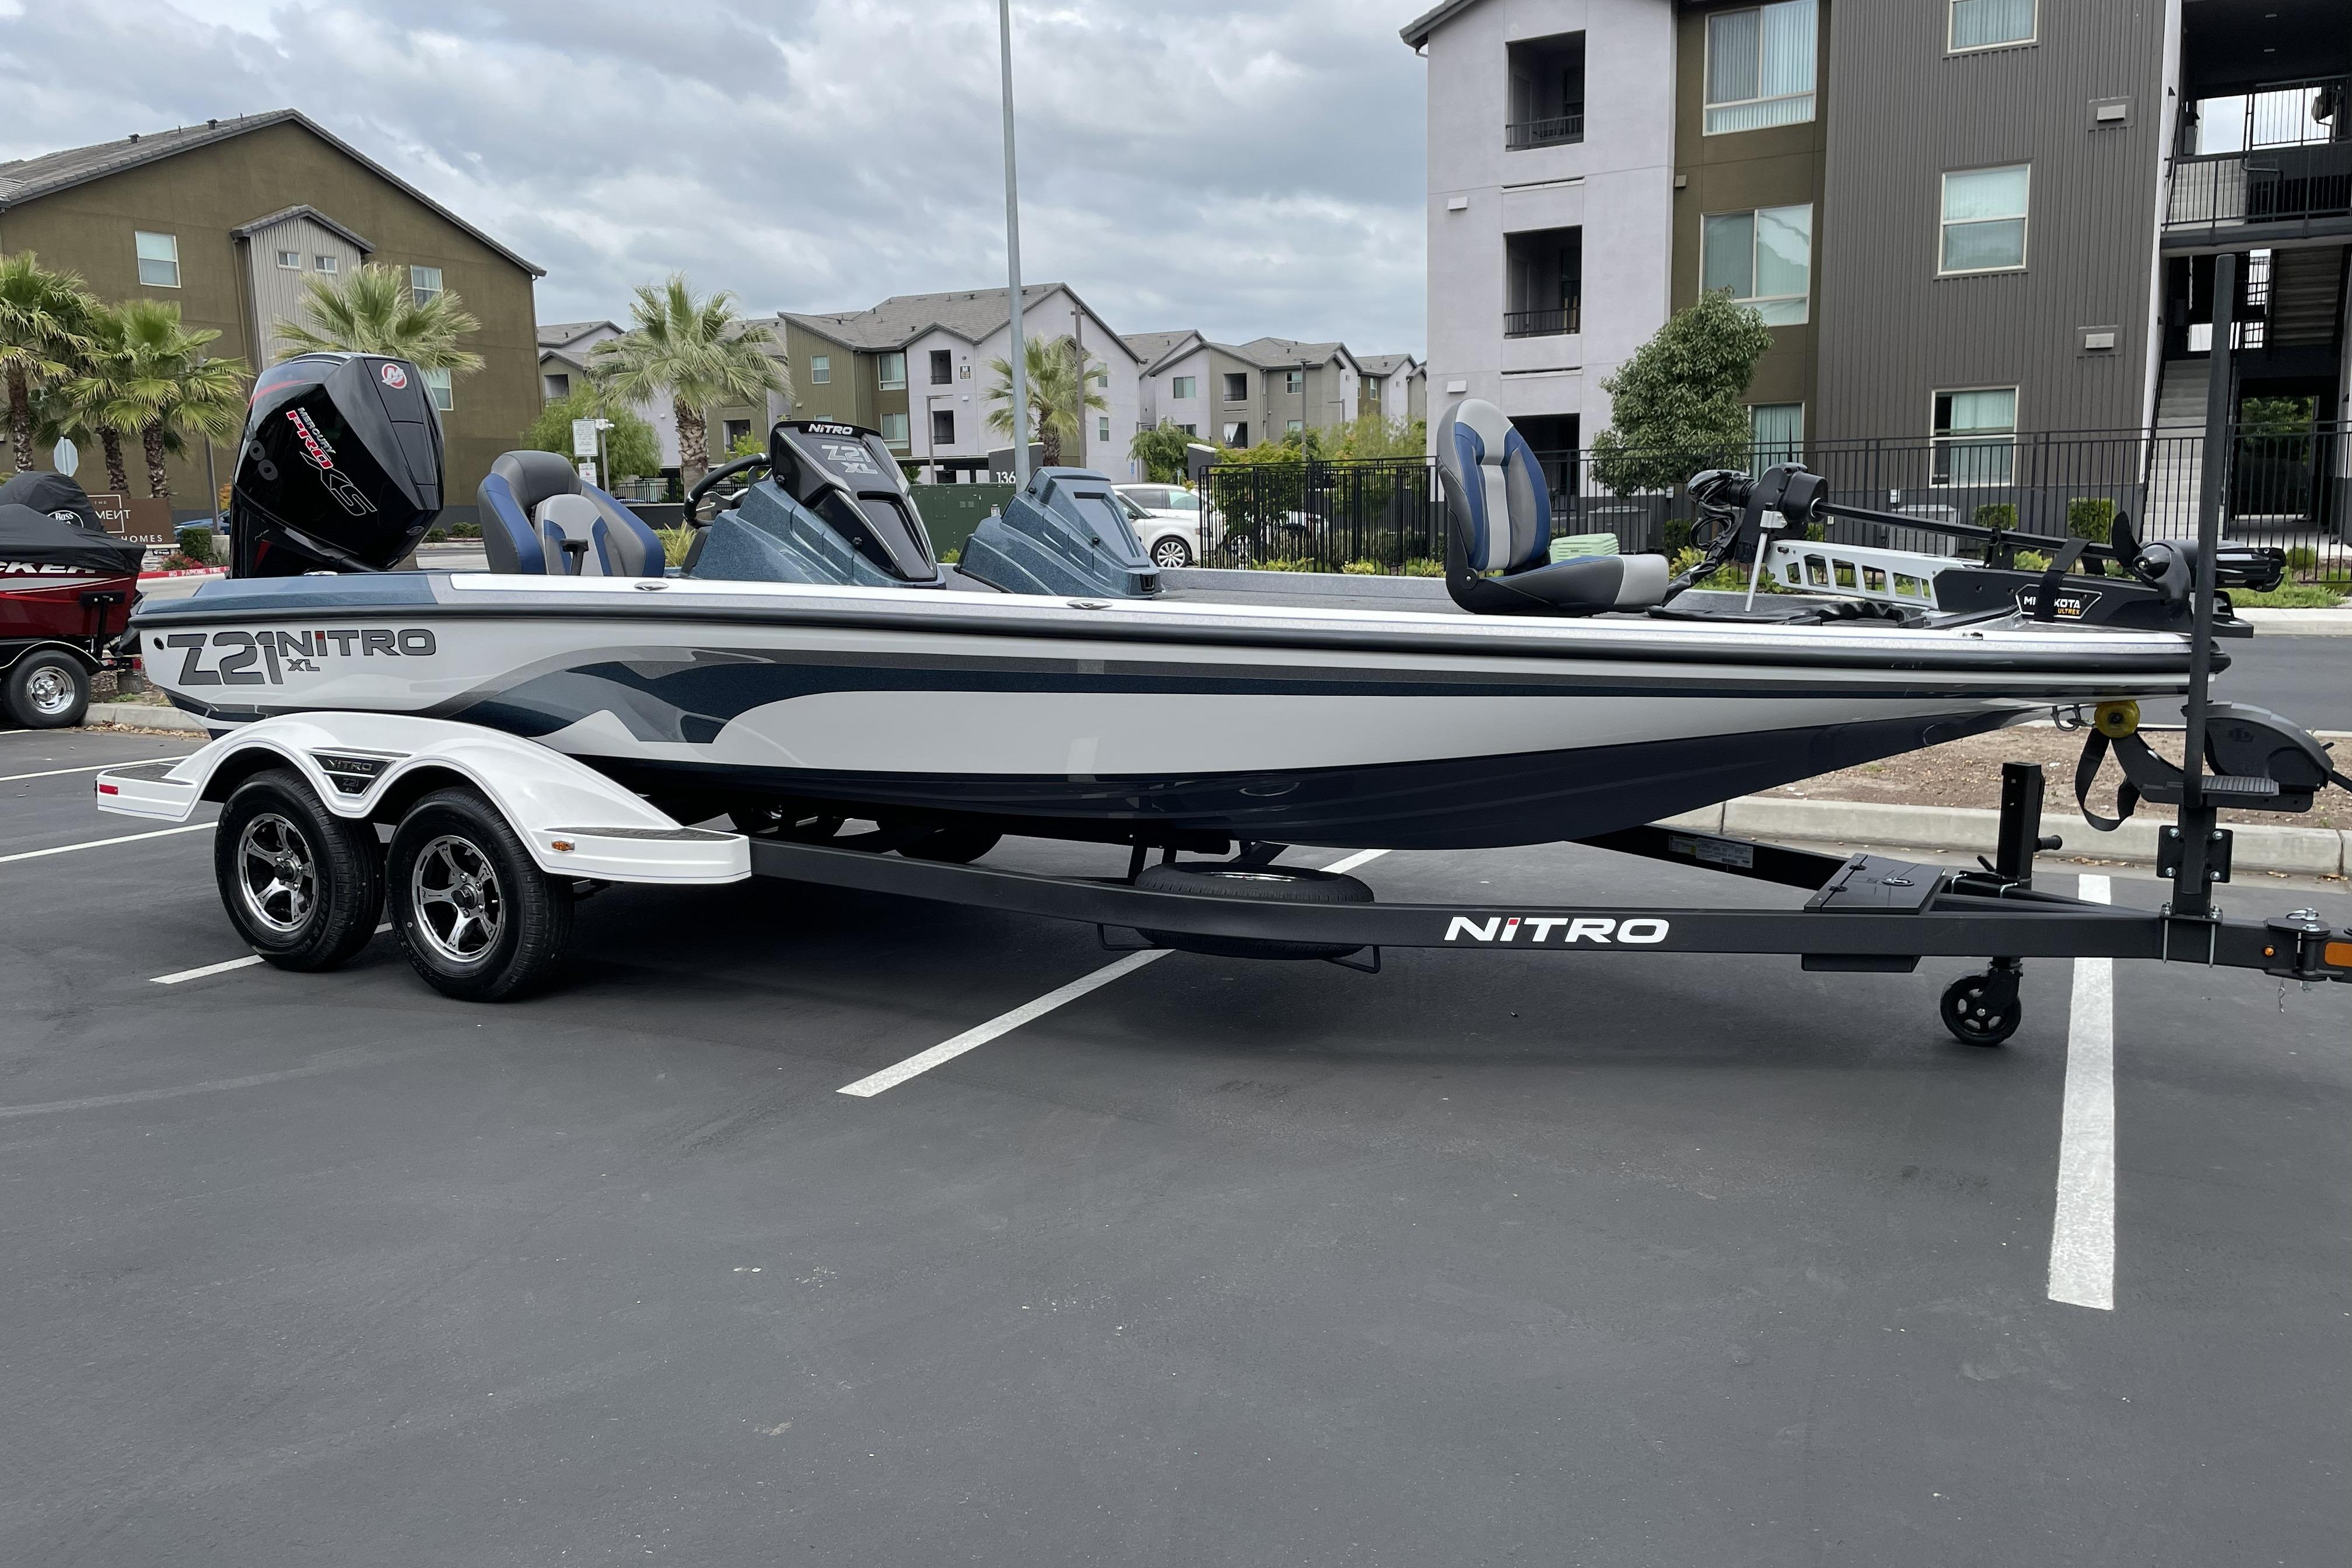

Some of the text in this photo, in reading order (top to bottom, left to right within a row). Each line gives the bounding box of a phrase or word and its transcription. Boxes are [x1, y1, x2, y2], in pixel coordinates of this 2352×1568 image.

[298, 407, 336, 454] MERCURY
[821, 444, 872, 463] Z21
[286, 410, 377, 516] PRO XS
[841, 461, 878, 474] XL
[996, 471, 1016, 484] 136
[181, 568, 206, 576] PARKING
[167, 631, 284, 685] Z21
[286, 659, 320, 671] XL
[342, 778, 360, 789] Z21
